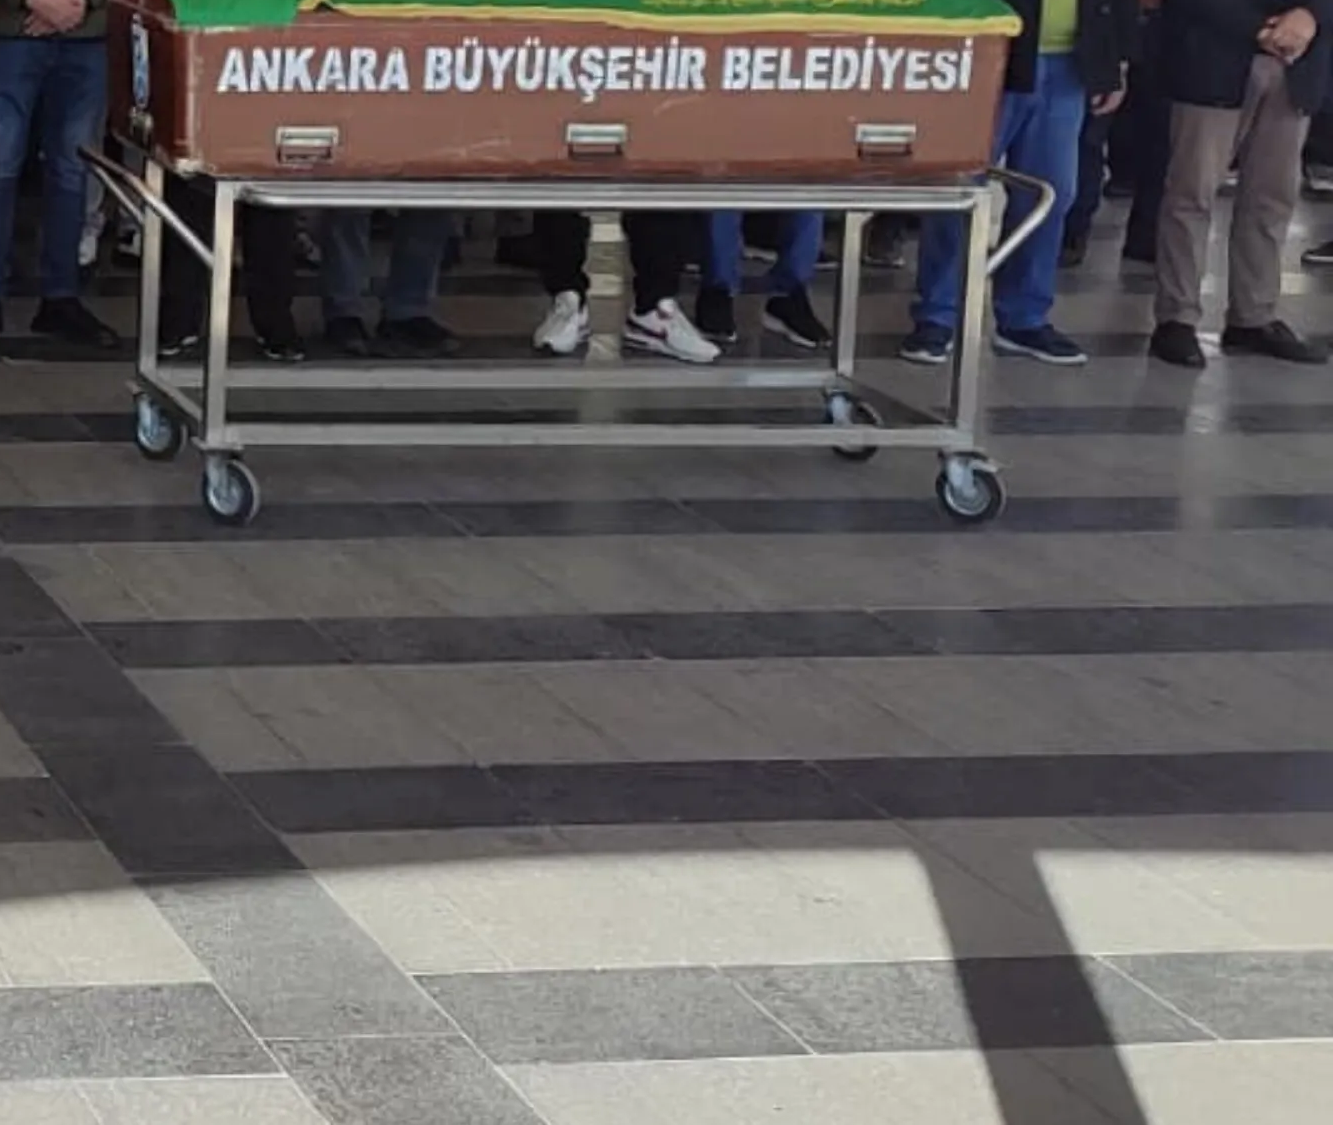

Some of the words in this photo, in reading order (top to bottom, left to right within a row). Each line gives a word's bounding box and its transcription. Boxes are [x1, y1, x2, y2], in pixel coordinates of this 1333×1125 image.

[217, 47, 410, 92] ANKARA
[423, 36, 707, 103] BÜYÜKŞEHİR
[721, 36, 973, 91] BELEDİYESİ
